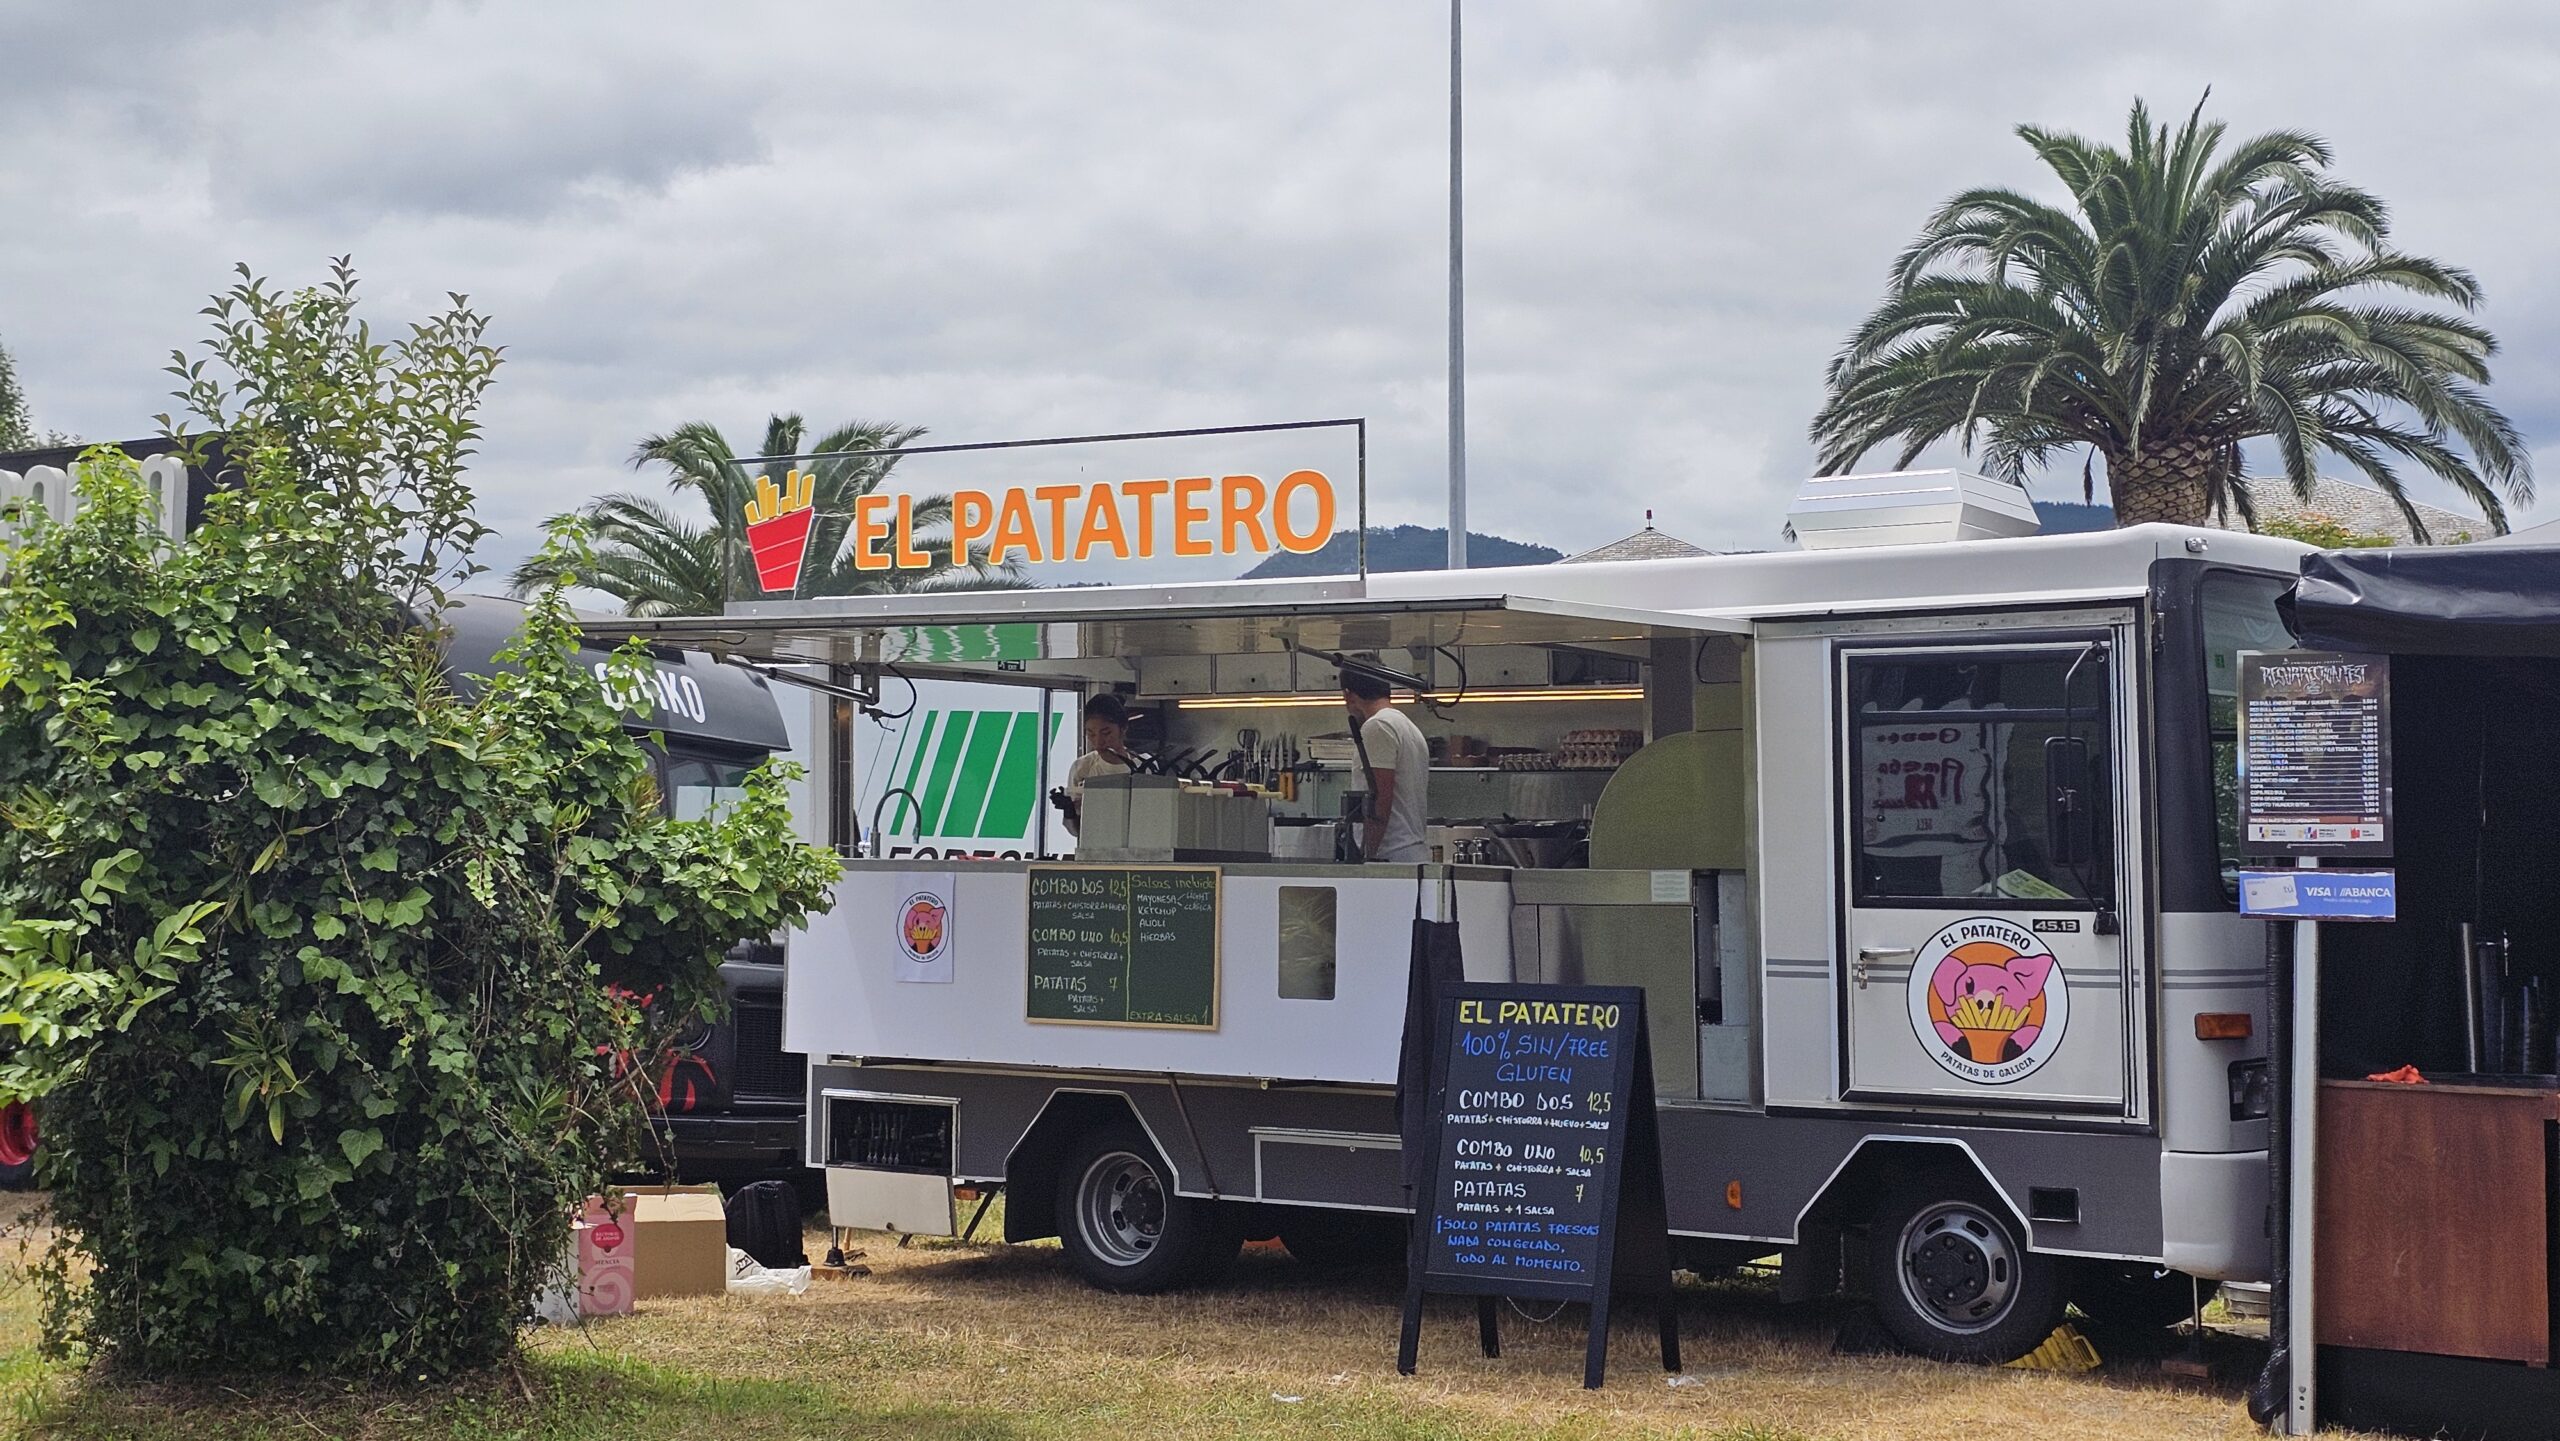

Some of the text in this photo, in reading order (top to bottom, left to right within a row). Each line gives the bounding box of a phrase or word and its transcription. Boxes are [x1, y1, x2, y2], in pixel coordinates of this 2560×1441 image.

[855, 469, 1337, 570] EL PATATERO
[2342, 664, 2368, 686] FEST
[1032, 877, 1127, 898] COMBO DOS 12,5
[1132, 874, 1172, 889] Salsas
[1137, 893, 1177, 907] MAYONESA
[2304, 887, 2332, 896] VISA
[1138, 906, 1177, 916] KETCHUP
[2034, 920, 2078, 931] 45.13
[1032, 928, 1128, 947] COMBO UNO 10,5
[1940, 924, 2031, 951] EL PATATERO
[1038, 948, 1069, 958] PATATAS
[1034, 974, 1118, 993] PATATAS 7
[1130, 1005, 1208, 1025] EXTRA SALSA 1
[1460, 1000, 1620, 1031] EL PATATERO
[1462, 1029, 1511, 1060] 100%
[1497, 1063, 1572, 1084] GLUTEN
[1941, 1051, 2036, 1079] PATATAS DE GALICIA
[1460, 1090, 1612, 1115] COMBO DOS 12,5
[1447, 1113, 1488, 1125] PATATAS
[1457, 1138, 1605, 1165] COMBO UNO 10,5
[1454, 1160, 1493, 1171] PATATAS
[1454, 1180, 1584, 1203] PATATAS 7
[1456, 1202, 1500, 1213] PATATAS
[1524, 1205, 1555, 1215] SALSA
[1486, 1221, 1541, 1233] PATATAS
[1448, 1235, 1480, 1246] NADA
[1455, 1252, 1485, 1264] TODO
[1492, 1254, 1508, 1265] AL
